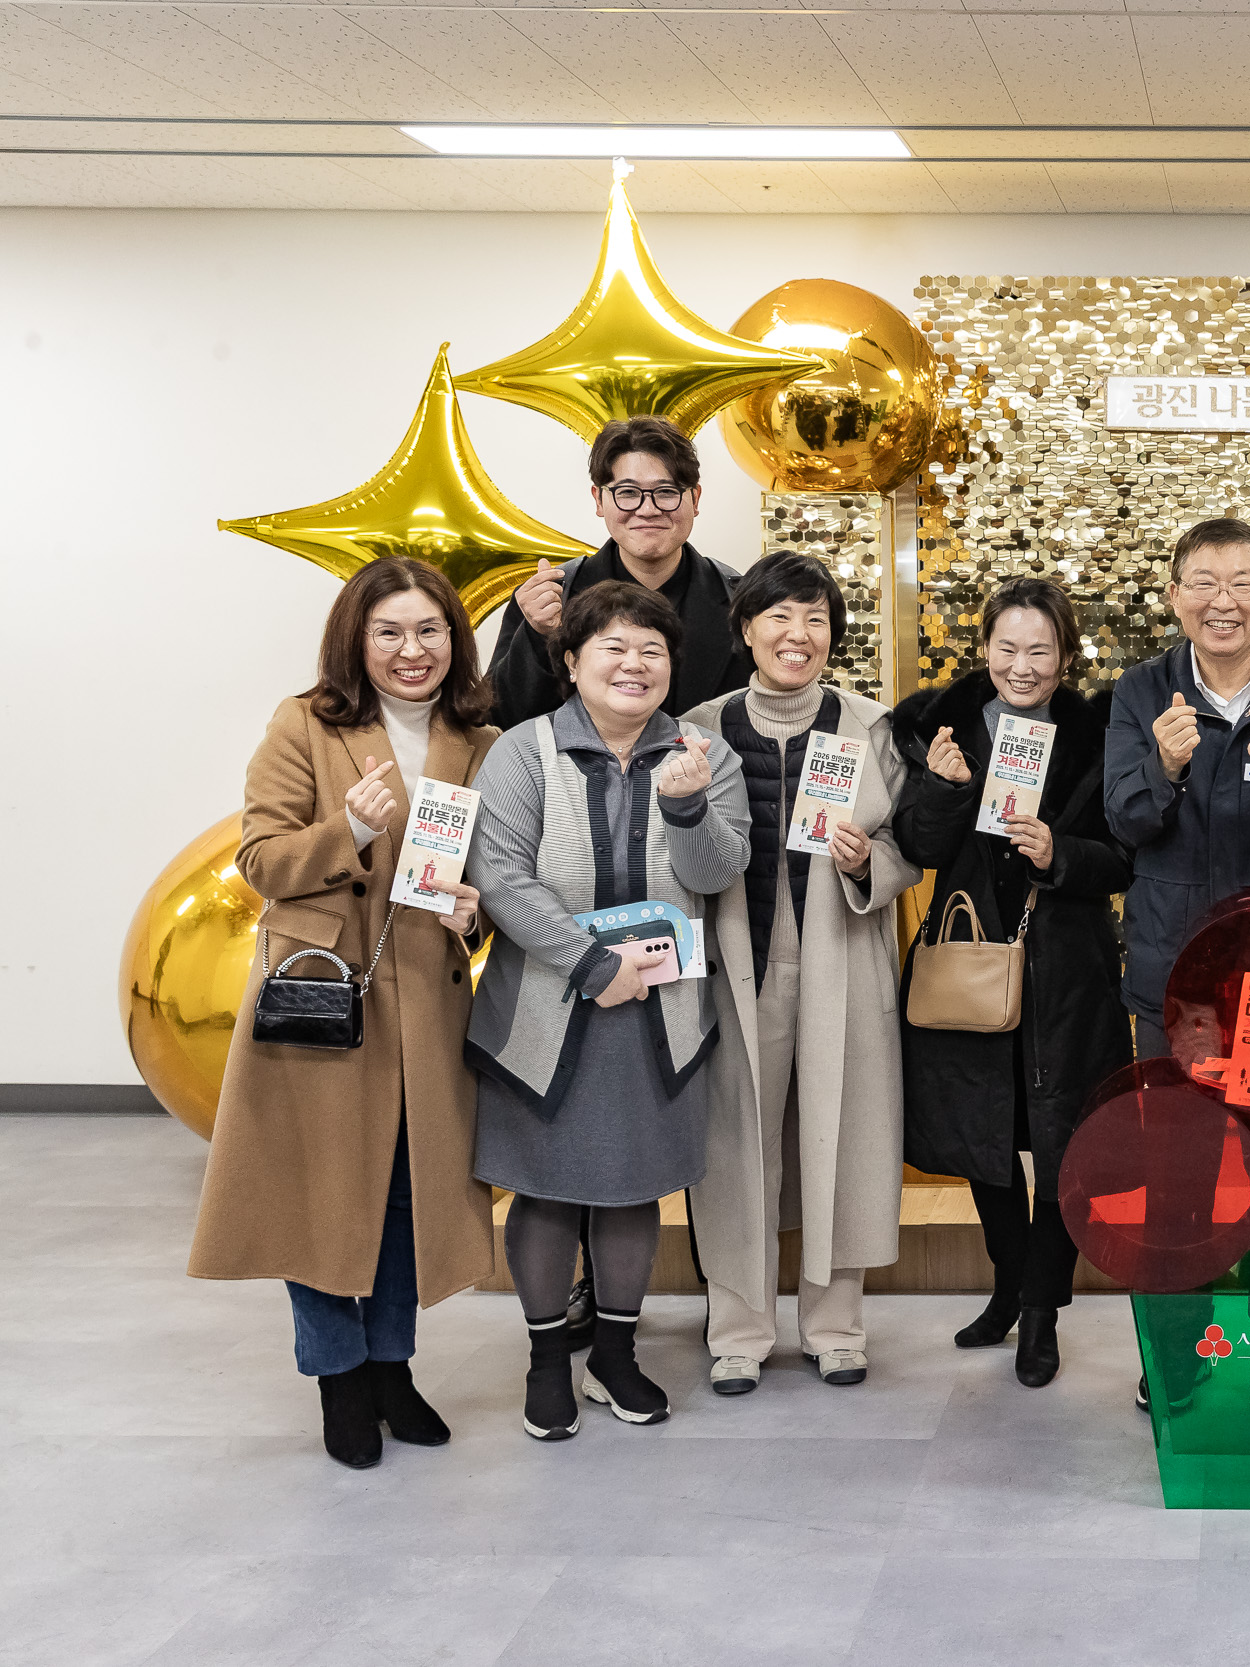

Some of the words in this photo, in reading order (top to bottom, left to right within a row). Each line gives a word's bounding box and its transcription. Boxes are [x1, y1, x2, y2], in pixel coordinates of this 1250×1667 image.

[1132, 384, 1197, 418] 광진
[1003, 734, 1018, 742] 2026
[813, 752, 830, 760] 2026
[1000, 741, 1044, 761] 따뜻한
[810, 759, 855, 778] 따뜻한
[998, 755, 1040, 772] 겨울나기
[808, 772, 852, 789] 겨울나기
[421, 798, 439, 808] 2026
[417, 806, 467, 829] 따뜻한
[415, 820, 463, 840] 겨울나기
